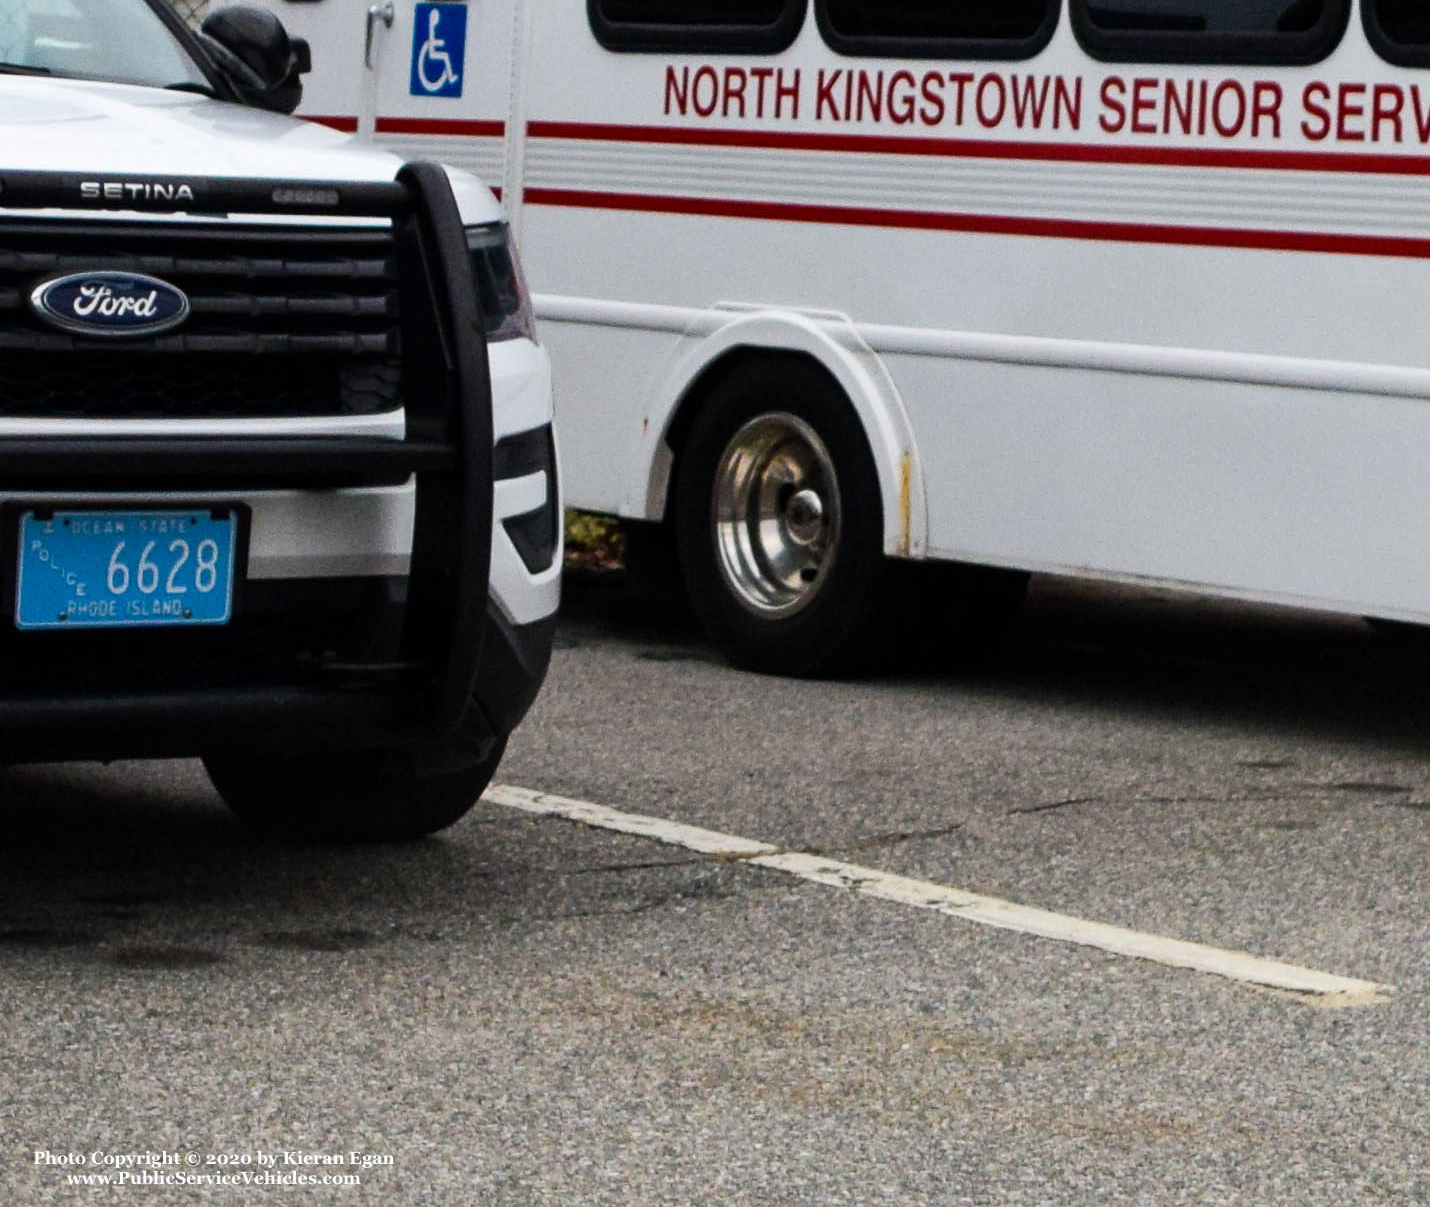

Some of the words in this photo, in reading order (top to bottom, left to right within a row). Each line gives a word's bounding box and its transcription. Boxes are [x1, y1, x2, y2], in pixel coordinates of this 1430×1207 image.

[663, 65, 801, 119] NORTH
[815, 68, 1083, 131] KINGSTOWN
[1098, 75, 1283, 139] SENIOR
[80, 181, 194, 201] SETINA
[73, 285, 158, 317] Ford
[71, 520, 125, 534] OCEAN
[138, 520, 187, 534] STATE
[107, 538, 218, 595] 6628
[67, 600, 117, 617] RHODE
[126, 599, 183, 616] ISLAND
